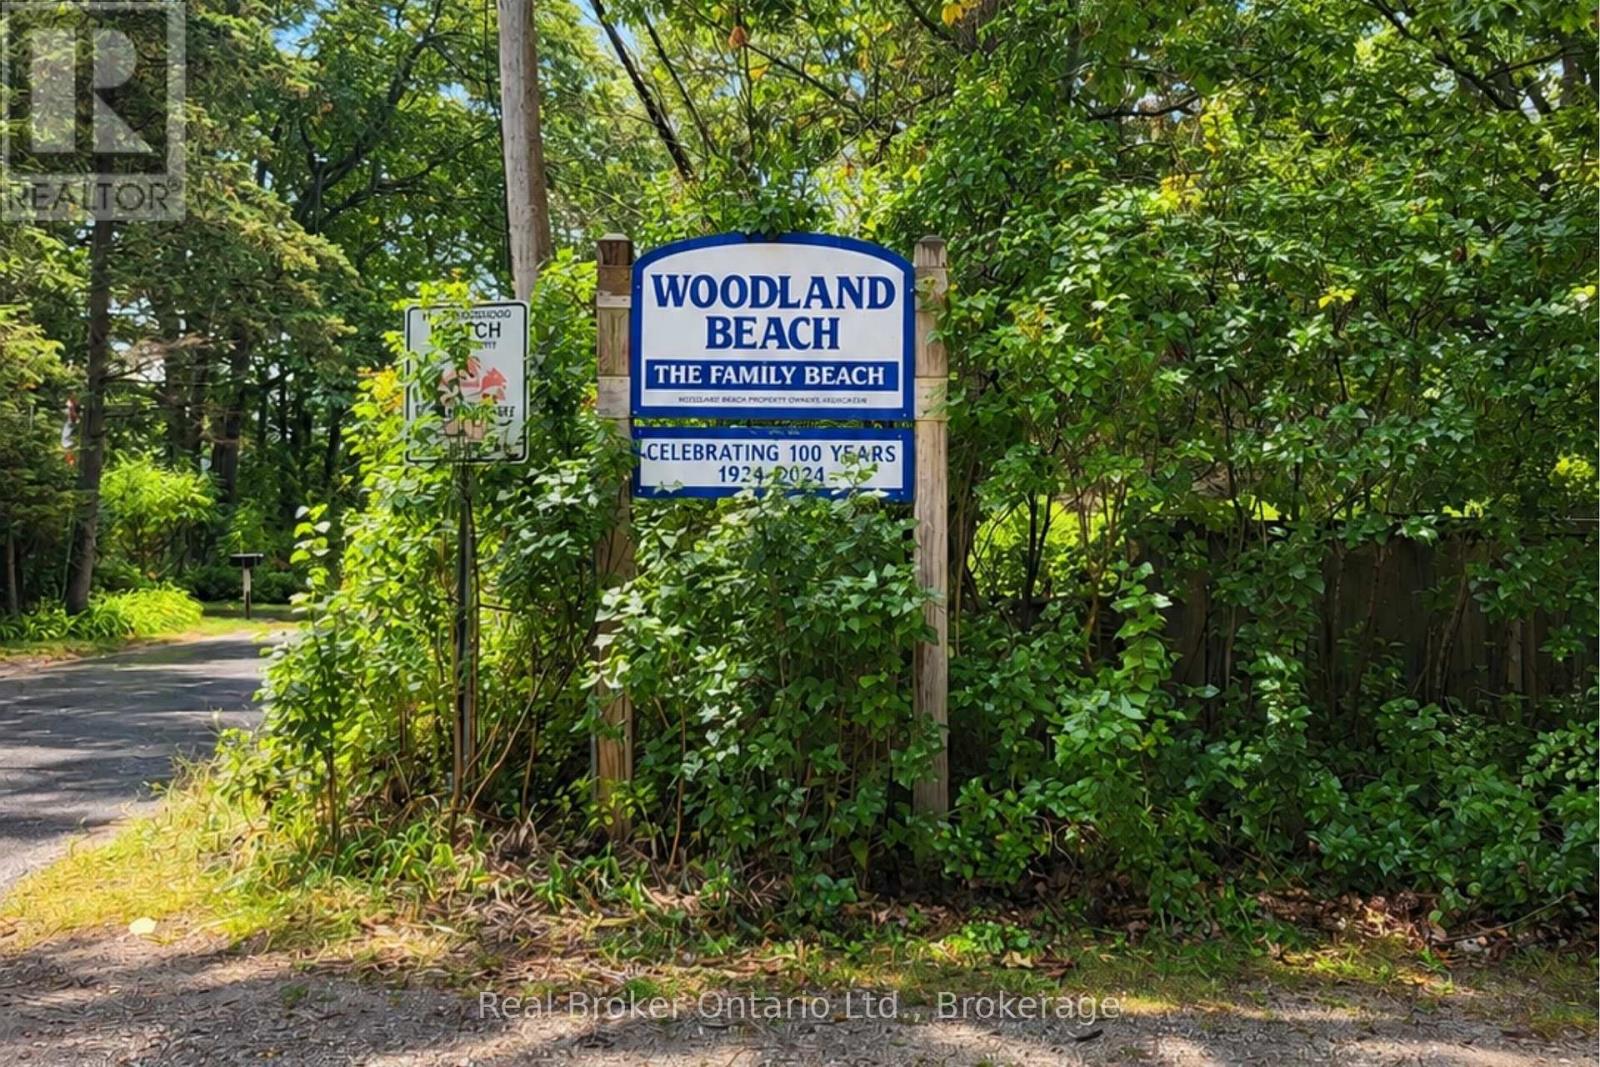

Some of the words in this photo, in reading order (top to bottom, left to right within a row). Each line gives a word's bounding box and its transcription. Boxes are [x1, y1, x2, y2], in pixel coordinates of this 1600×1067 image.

[651, 273, 897, 310] WOODLAND
[705, 316, 840, 350] BEACH
[654, 365, 702, 384] THE
[710, 365, 796, 385] FAMILY
[804, 366, 885, 386] BEACH
[647, 443, 779, 462] CELEBRATING
[790, 445, 822, 462] 100
[830, 445, 896, 463] YEARS
